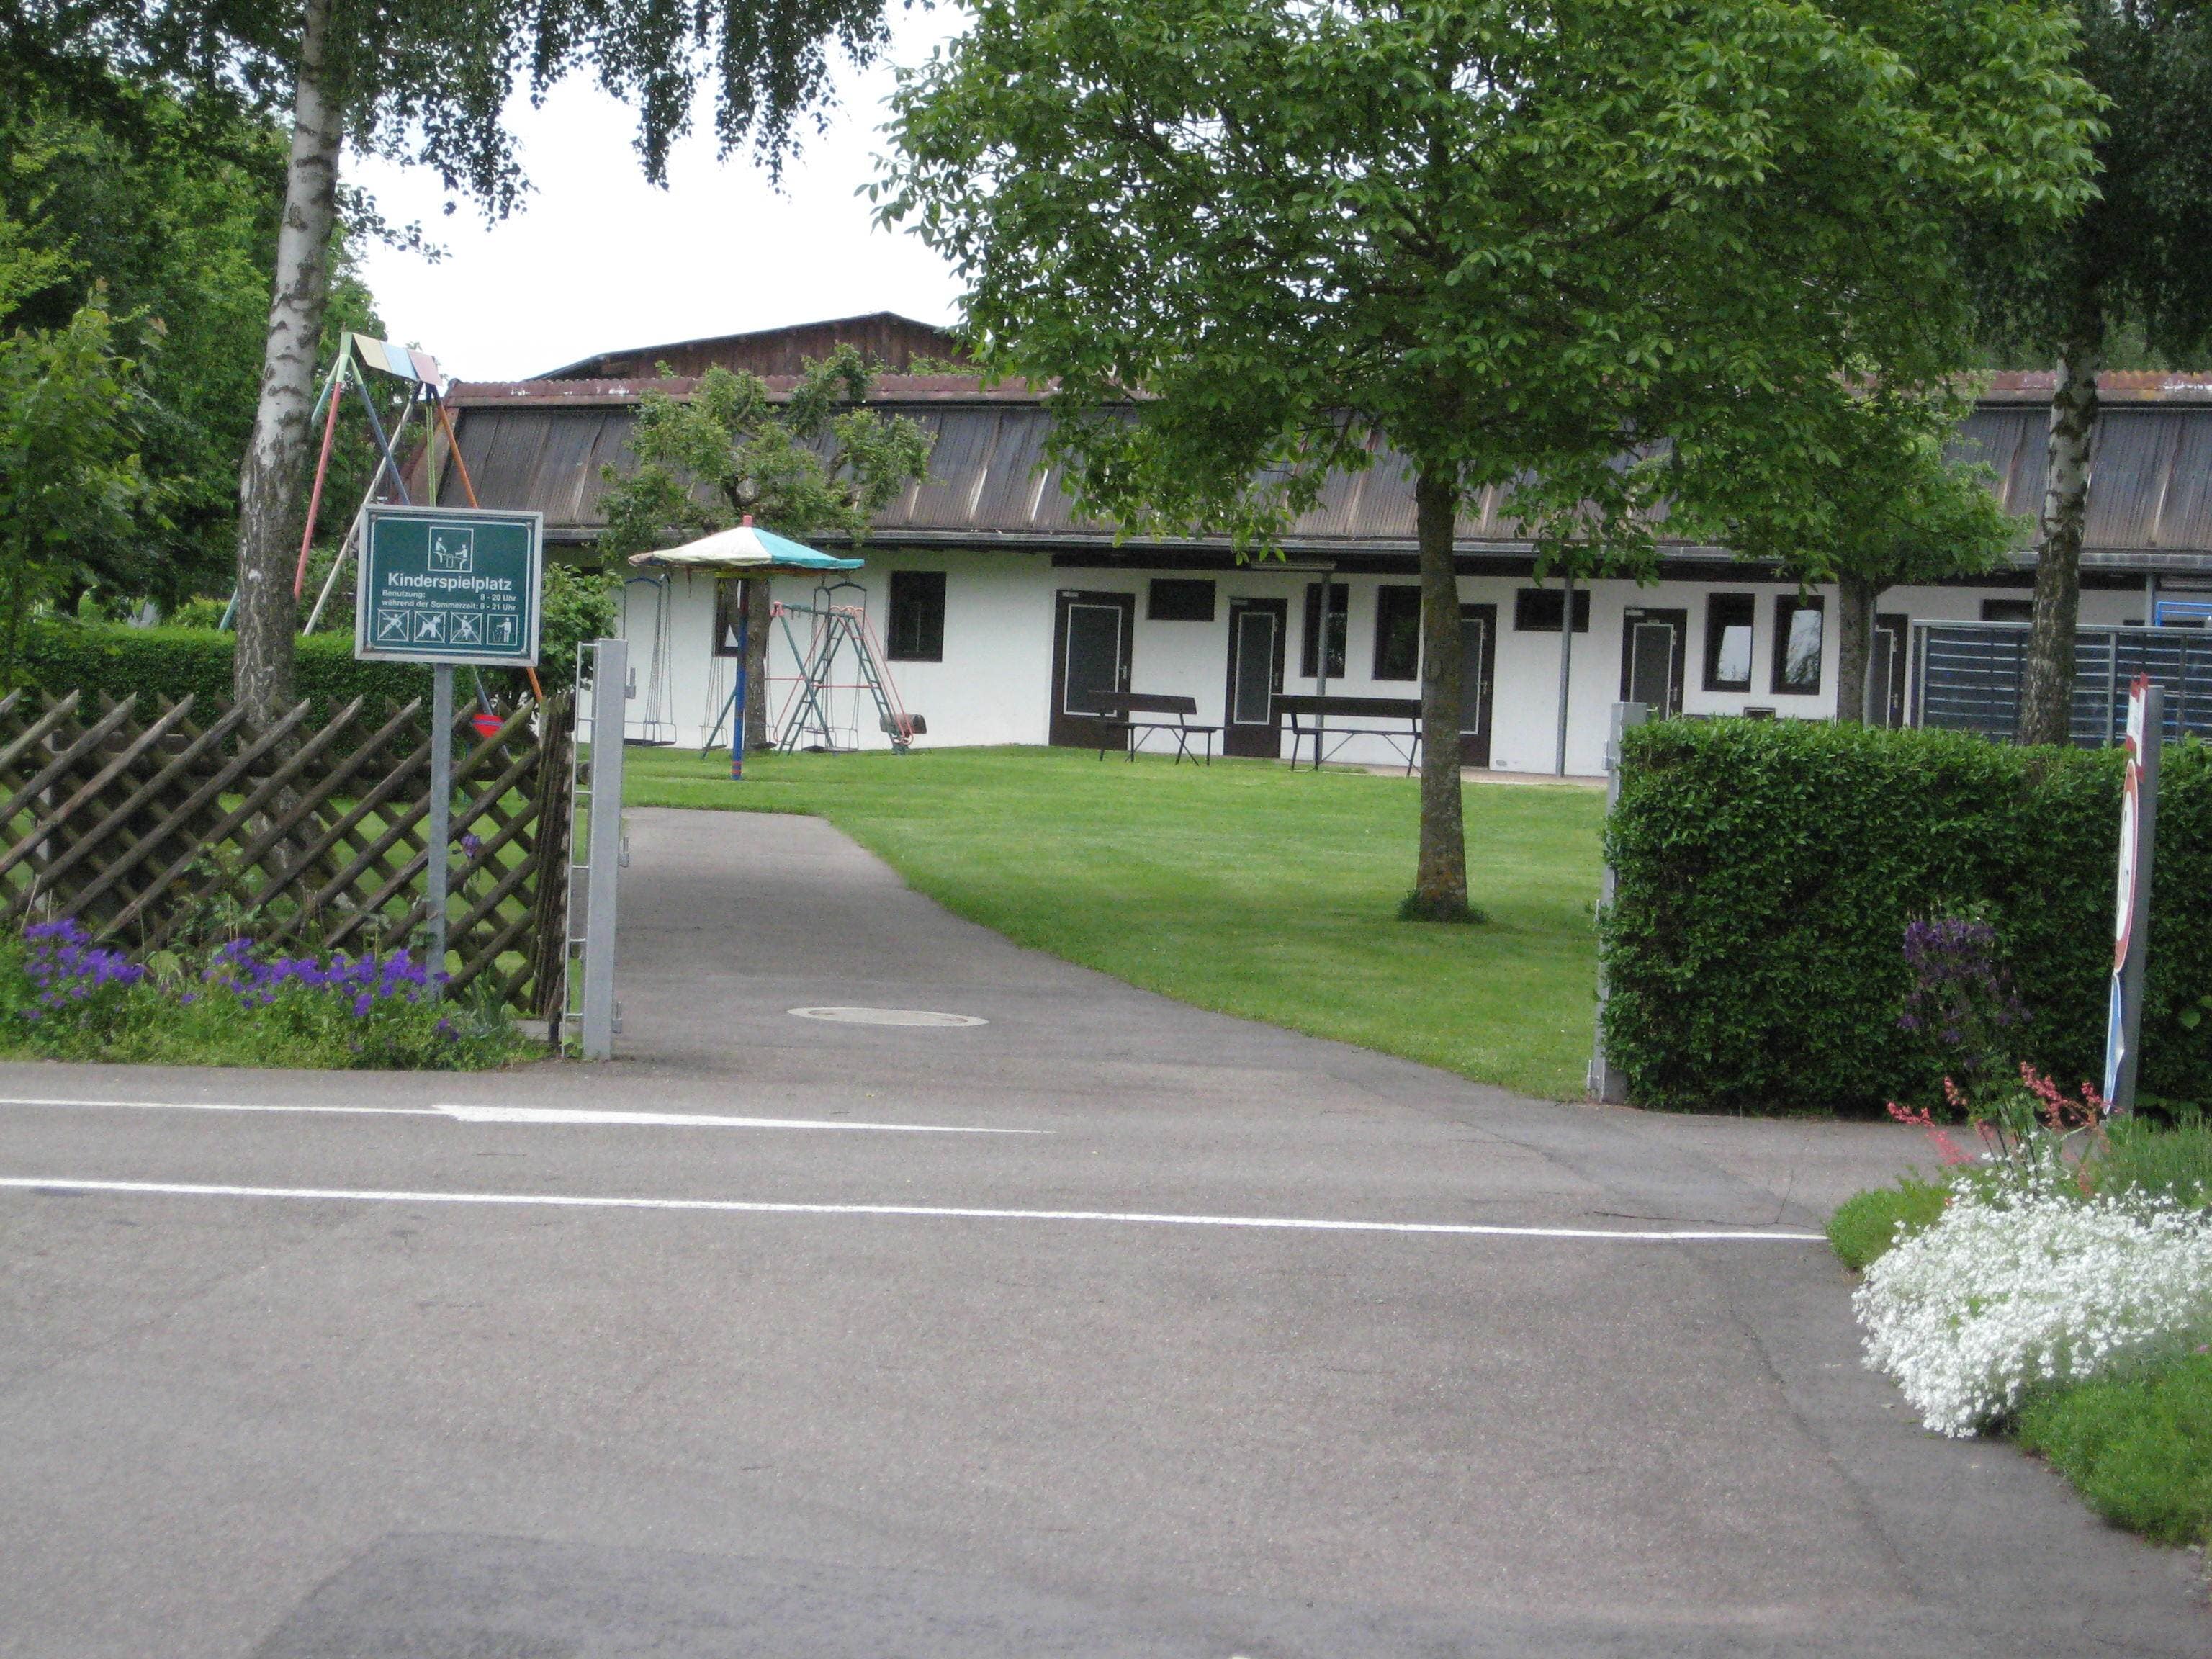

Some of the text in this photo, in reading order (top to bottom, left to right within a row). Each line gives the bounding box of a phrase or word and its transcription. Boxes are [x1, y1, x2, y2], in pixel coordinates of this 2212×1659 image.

[388, 572, 512, 593] Kinderspielplatz
[382, 589, 426, 599] Benutzung:
[480, 593, 485, 601] 8
[381, 599, 415, 608] während
[415, 600, 429, 608] der
[431, 601, 479, 610] Sommerzeit:
